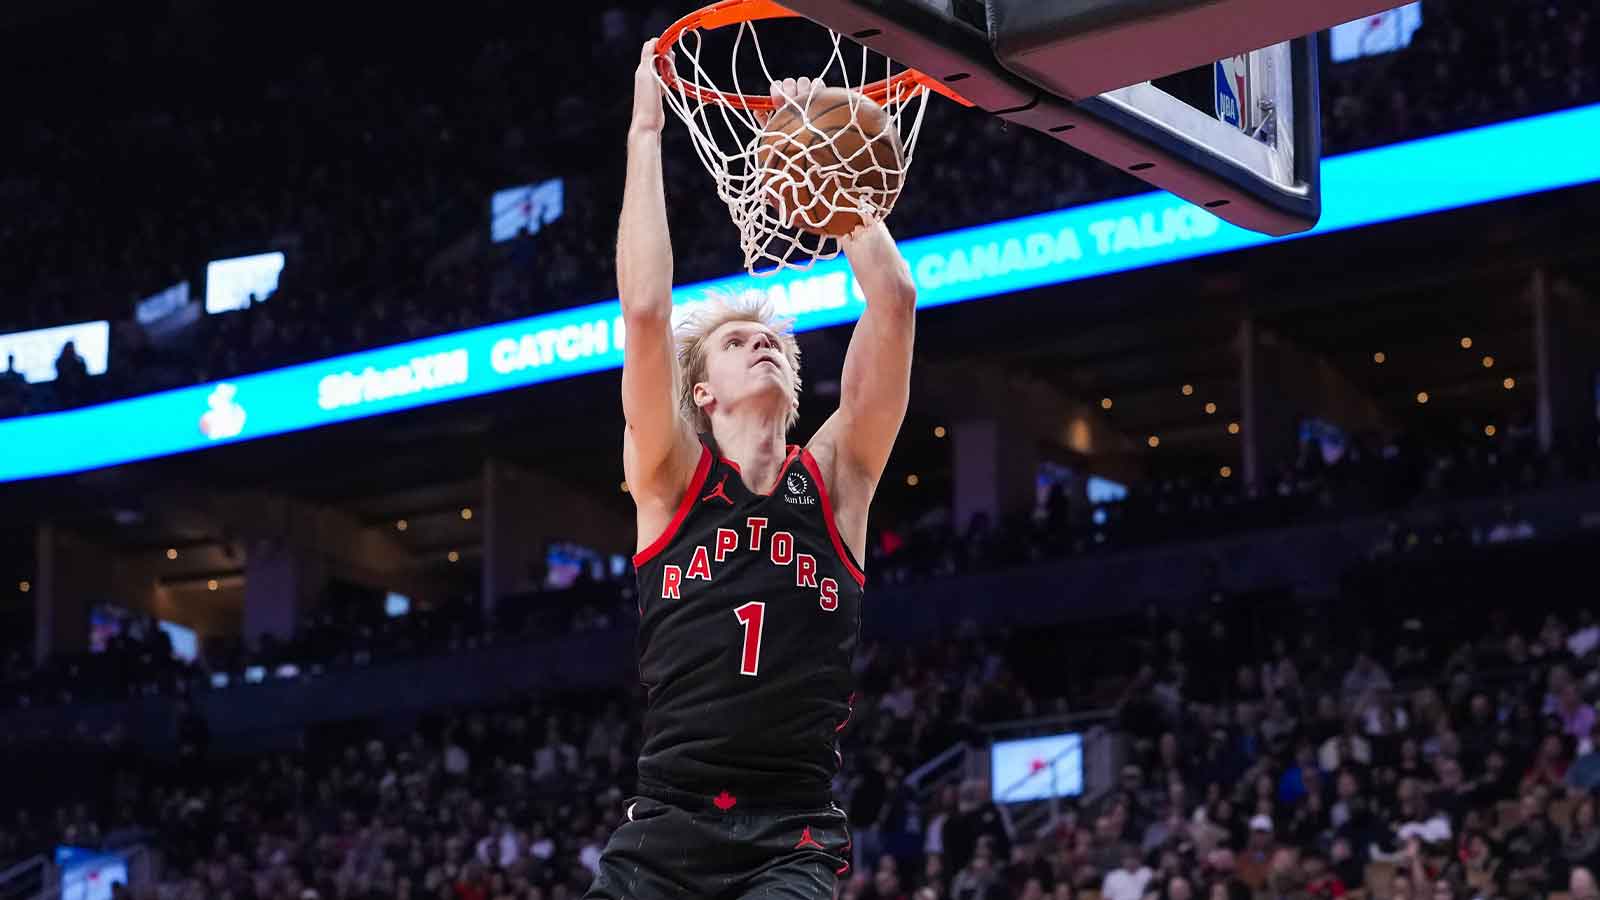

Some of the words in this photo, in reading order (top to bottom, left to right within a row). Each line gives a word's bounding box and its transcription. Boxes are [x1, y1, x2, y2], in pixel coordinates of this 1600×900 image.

[1220, 92, 1236, 120] NBA
[318, 348, 468, 409] SiriusXM
[491, 320, 608, 373] CATCH
[916, 229, 1081, 289] CANADA
[1088, 204, 1220, 254] TALKS
[784, 494, 798, 504] Sun
[798, 495, 815, 505] Life
[662, 517, 839, 611] RAPTORS
[734, 601, 765, 676] 1
